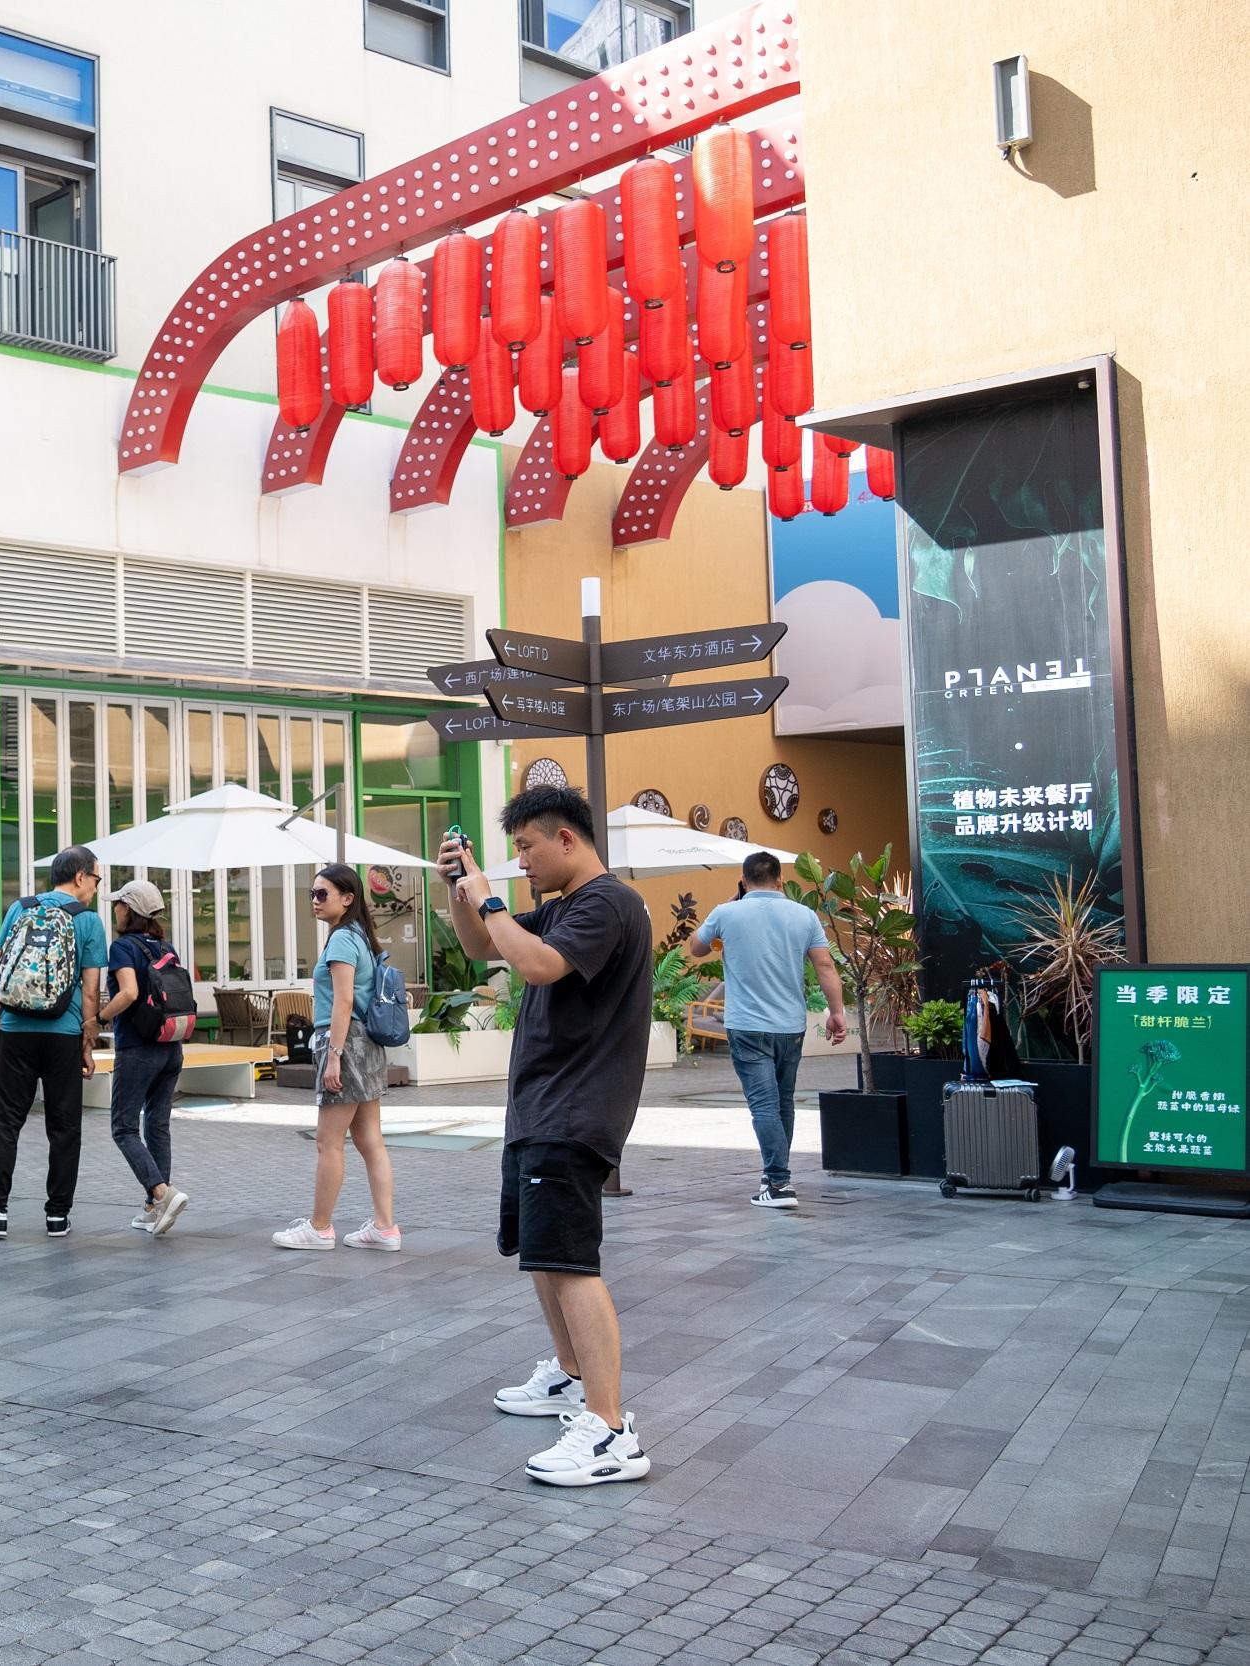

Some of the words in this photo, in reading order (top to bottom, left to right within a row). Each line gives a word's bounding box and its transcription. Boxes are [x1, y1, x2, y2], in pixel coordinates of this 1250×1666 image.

[517, 644, 540, 659] LOFT
[541, 648, 549, 661] D
[642, 639, 735, 664] 文华东方酒店
[944, 685, 1014, 699] GREEN
[516, 697, 566, 716] 写字楼A/B座
[612, 691, 737, 717] 东广场/笔架山公园
[465, 716, 497, 731] LOFT
[952, 782, 1093, 811] 植物未来餐厅
[954, 809, 1093, 836] 品牌升级计划
[1116, 985, 1231, 1005] 当季限定
